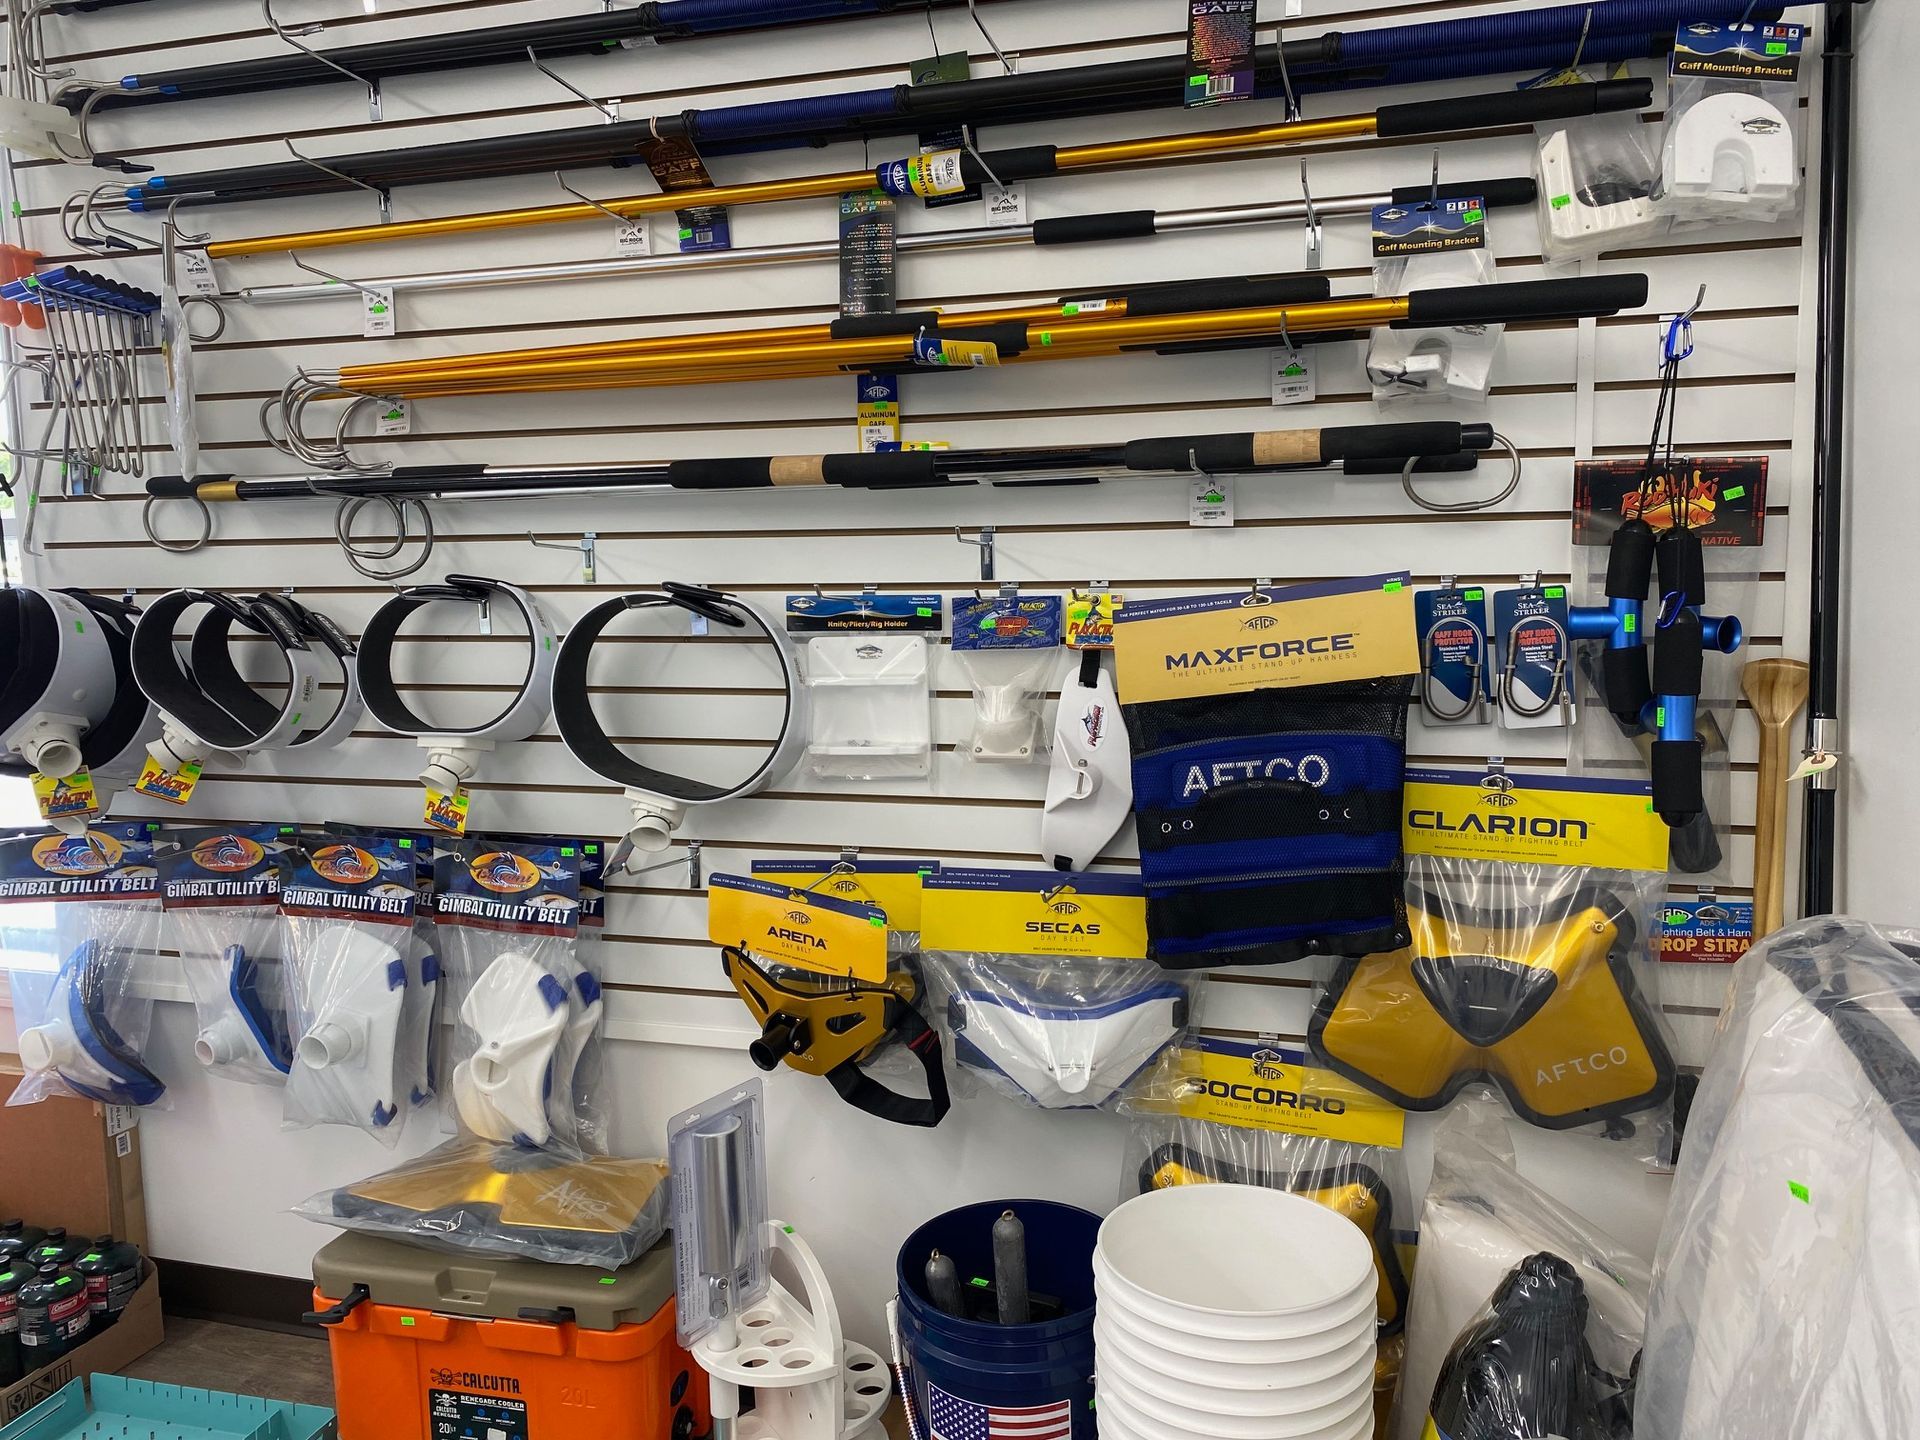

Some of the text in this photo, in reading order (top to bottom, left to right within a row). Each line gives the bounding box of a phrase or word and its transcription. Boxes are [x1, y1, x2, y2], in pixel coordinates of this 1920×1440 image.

[1192, 5, 1253, 14] GAFF
[1679, 62, 1793, 75] Gaff Mounting Bracket
[653, 160, 700, 176] GAFF
[925, 163, 934, 184] GAFF
[916, 157, 931, 195] ALUMINUM
[841, 206, 877, 214] GAFF
[1377, 235, 1480, 252] Gaff Mounting Bracket
[867, 388, 889, 398] AFTCO
[859, 411, 896, 419] ALUMINUM
[1701, 536, 1742, 545] NATIVE
[1432, 608, 1468, 617] STRIKER
[1436, 602, 1453, 610] SEA
[1513, 606, 1550, 617] STRIKER
[1517, 602, 1534, 610] SEA
[1248, 617, 1276, 630] AFTCO
[1434, 629, 1474, 639] GAFF HOOK
[1535, 628, 1557, 637] HOOK
[1434, 637, 1474, 646] PROTECTOR
[1165, 633, 1355, 671] MAXFORCE
[1172, 651, 1359, 680] THE ULTIMATE STAND-UP HARNESS
[1486, 795, 1515, 808] AFTCO
[1408, 809, 1589, 840] CLARION
[1412, 829, 1585, 848] THE ULTIMATE STAND-UP FIGHTING BELT
[0, 877, 158, 896] GIMBAL UTILITY BELT
[167, 882, 215, 897] GIMBAL
[216, 880, 265, 896] UTILITY
[834, 880, 860, 893] AFTCO
[283, 890, 408, 914] GIMBAL UTILITY BELT
[415, 891, 433, 907] BEL
[438, 898, 571, 925] GIMBAL UTILITY BELT
[578, 899, 597, 915] ELT
[1053, 902, 1081, 915] AFTCO
[788, 912, 813, 925] AFTCO
[1025, 921, 1101, 935] SECAS
[1663, 928, 1752, 938] ghting Belt & Harn
[767, 926, 828, 950] ARENA
[1062, 935, 1086, 943] BELT
[796, 946, 812, 954] BELT
[1703, 937, 1752, 953] STRA
[1535, 1046, 1628, 1087] AFTCO
[1187, 1077, 1346, 1115] SOCORRO
[1255, 1106, 1292, 1116] FIGHTING
[1294, 1110, 1314, 1119] BELT
[462, 1371, 521, 1394] CALCUTTA
[460, 1395, 525, 1410] RENEGADE COOLER
[432, 1411, 461, 1420] RENEGADE
[435, 1405, 458, 1415] CALCUTTA
[438, 1422, 451, 1434] 20
